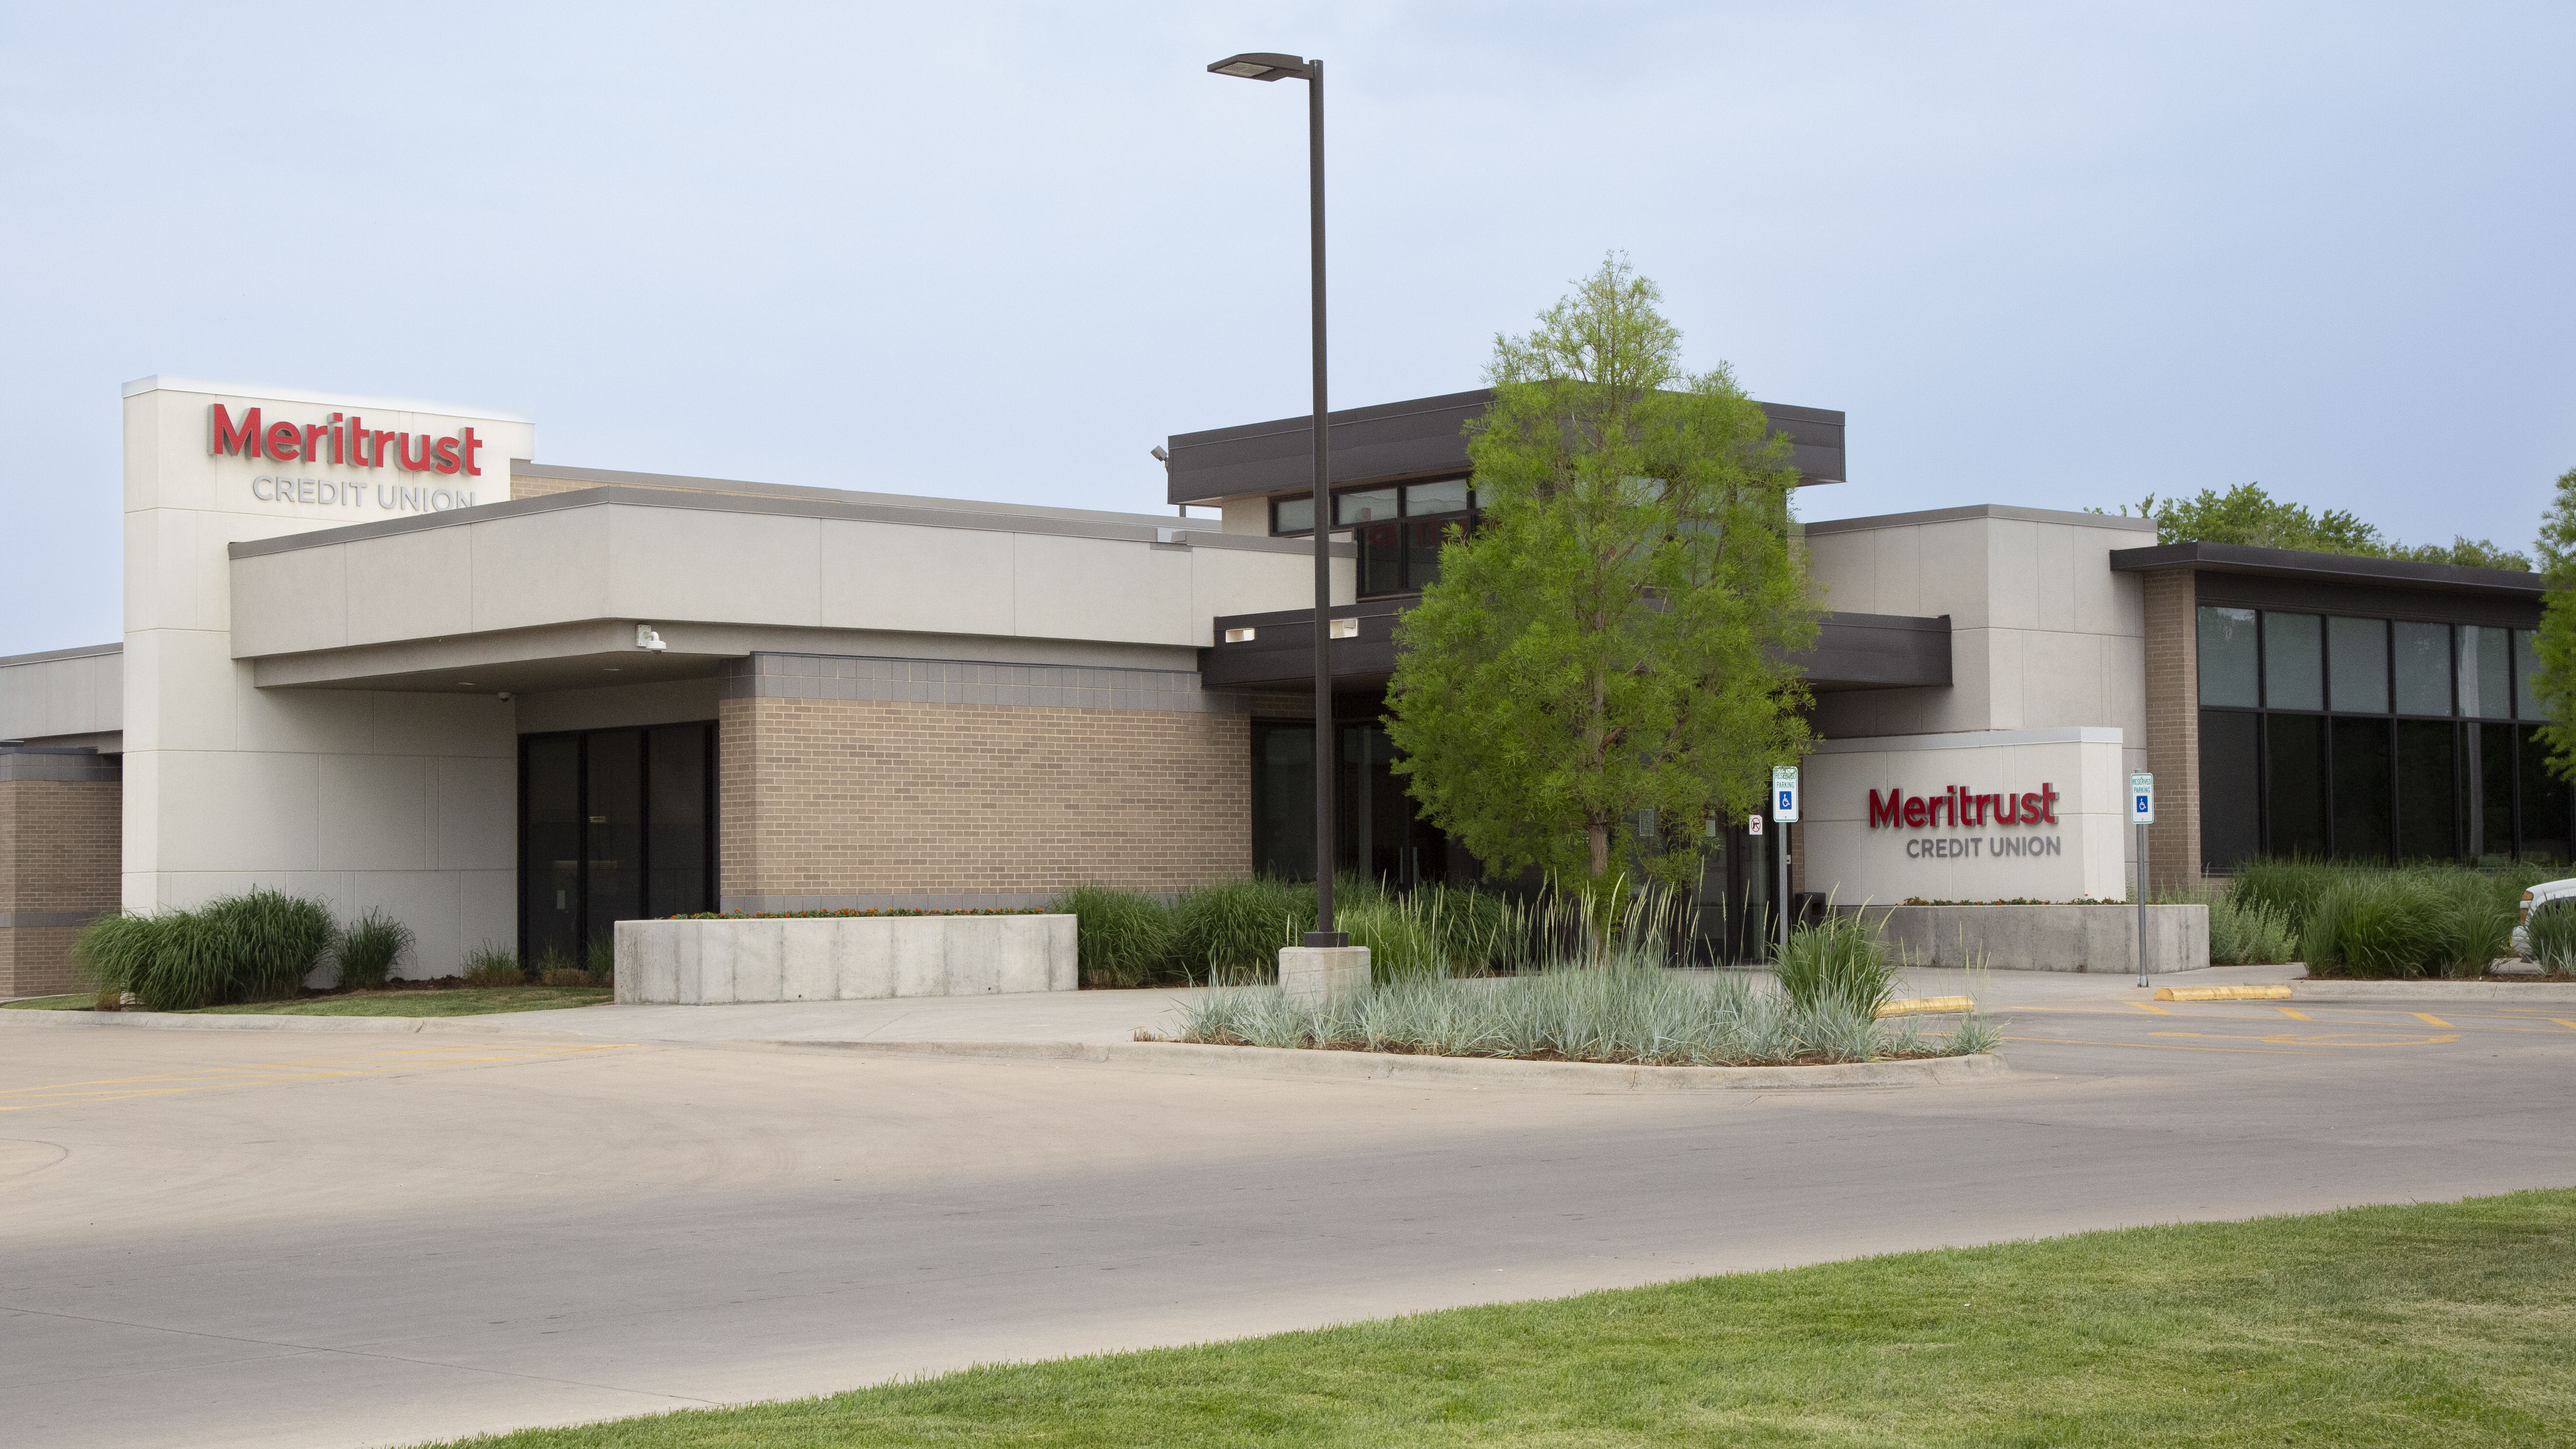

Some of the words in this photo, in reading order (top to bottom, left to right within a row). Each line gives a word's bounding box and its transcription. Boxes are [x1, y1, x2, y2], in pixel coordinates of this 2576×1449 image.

[208, 403, 483, 477] Meritrust
[253, 475, 368, 507] CREDIT
[378, 484, 476, 512] UNION
[1869, 782, 2060, 828] Meritrust
[1907, 838, 1983, 858] CREDIT
[1990, 836, 2061, 858] UNION
